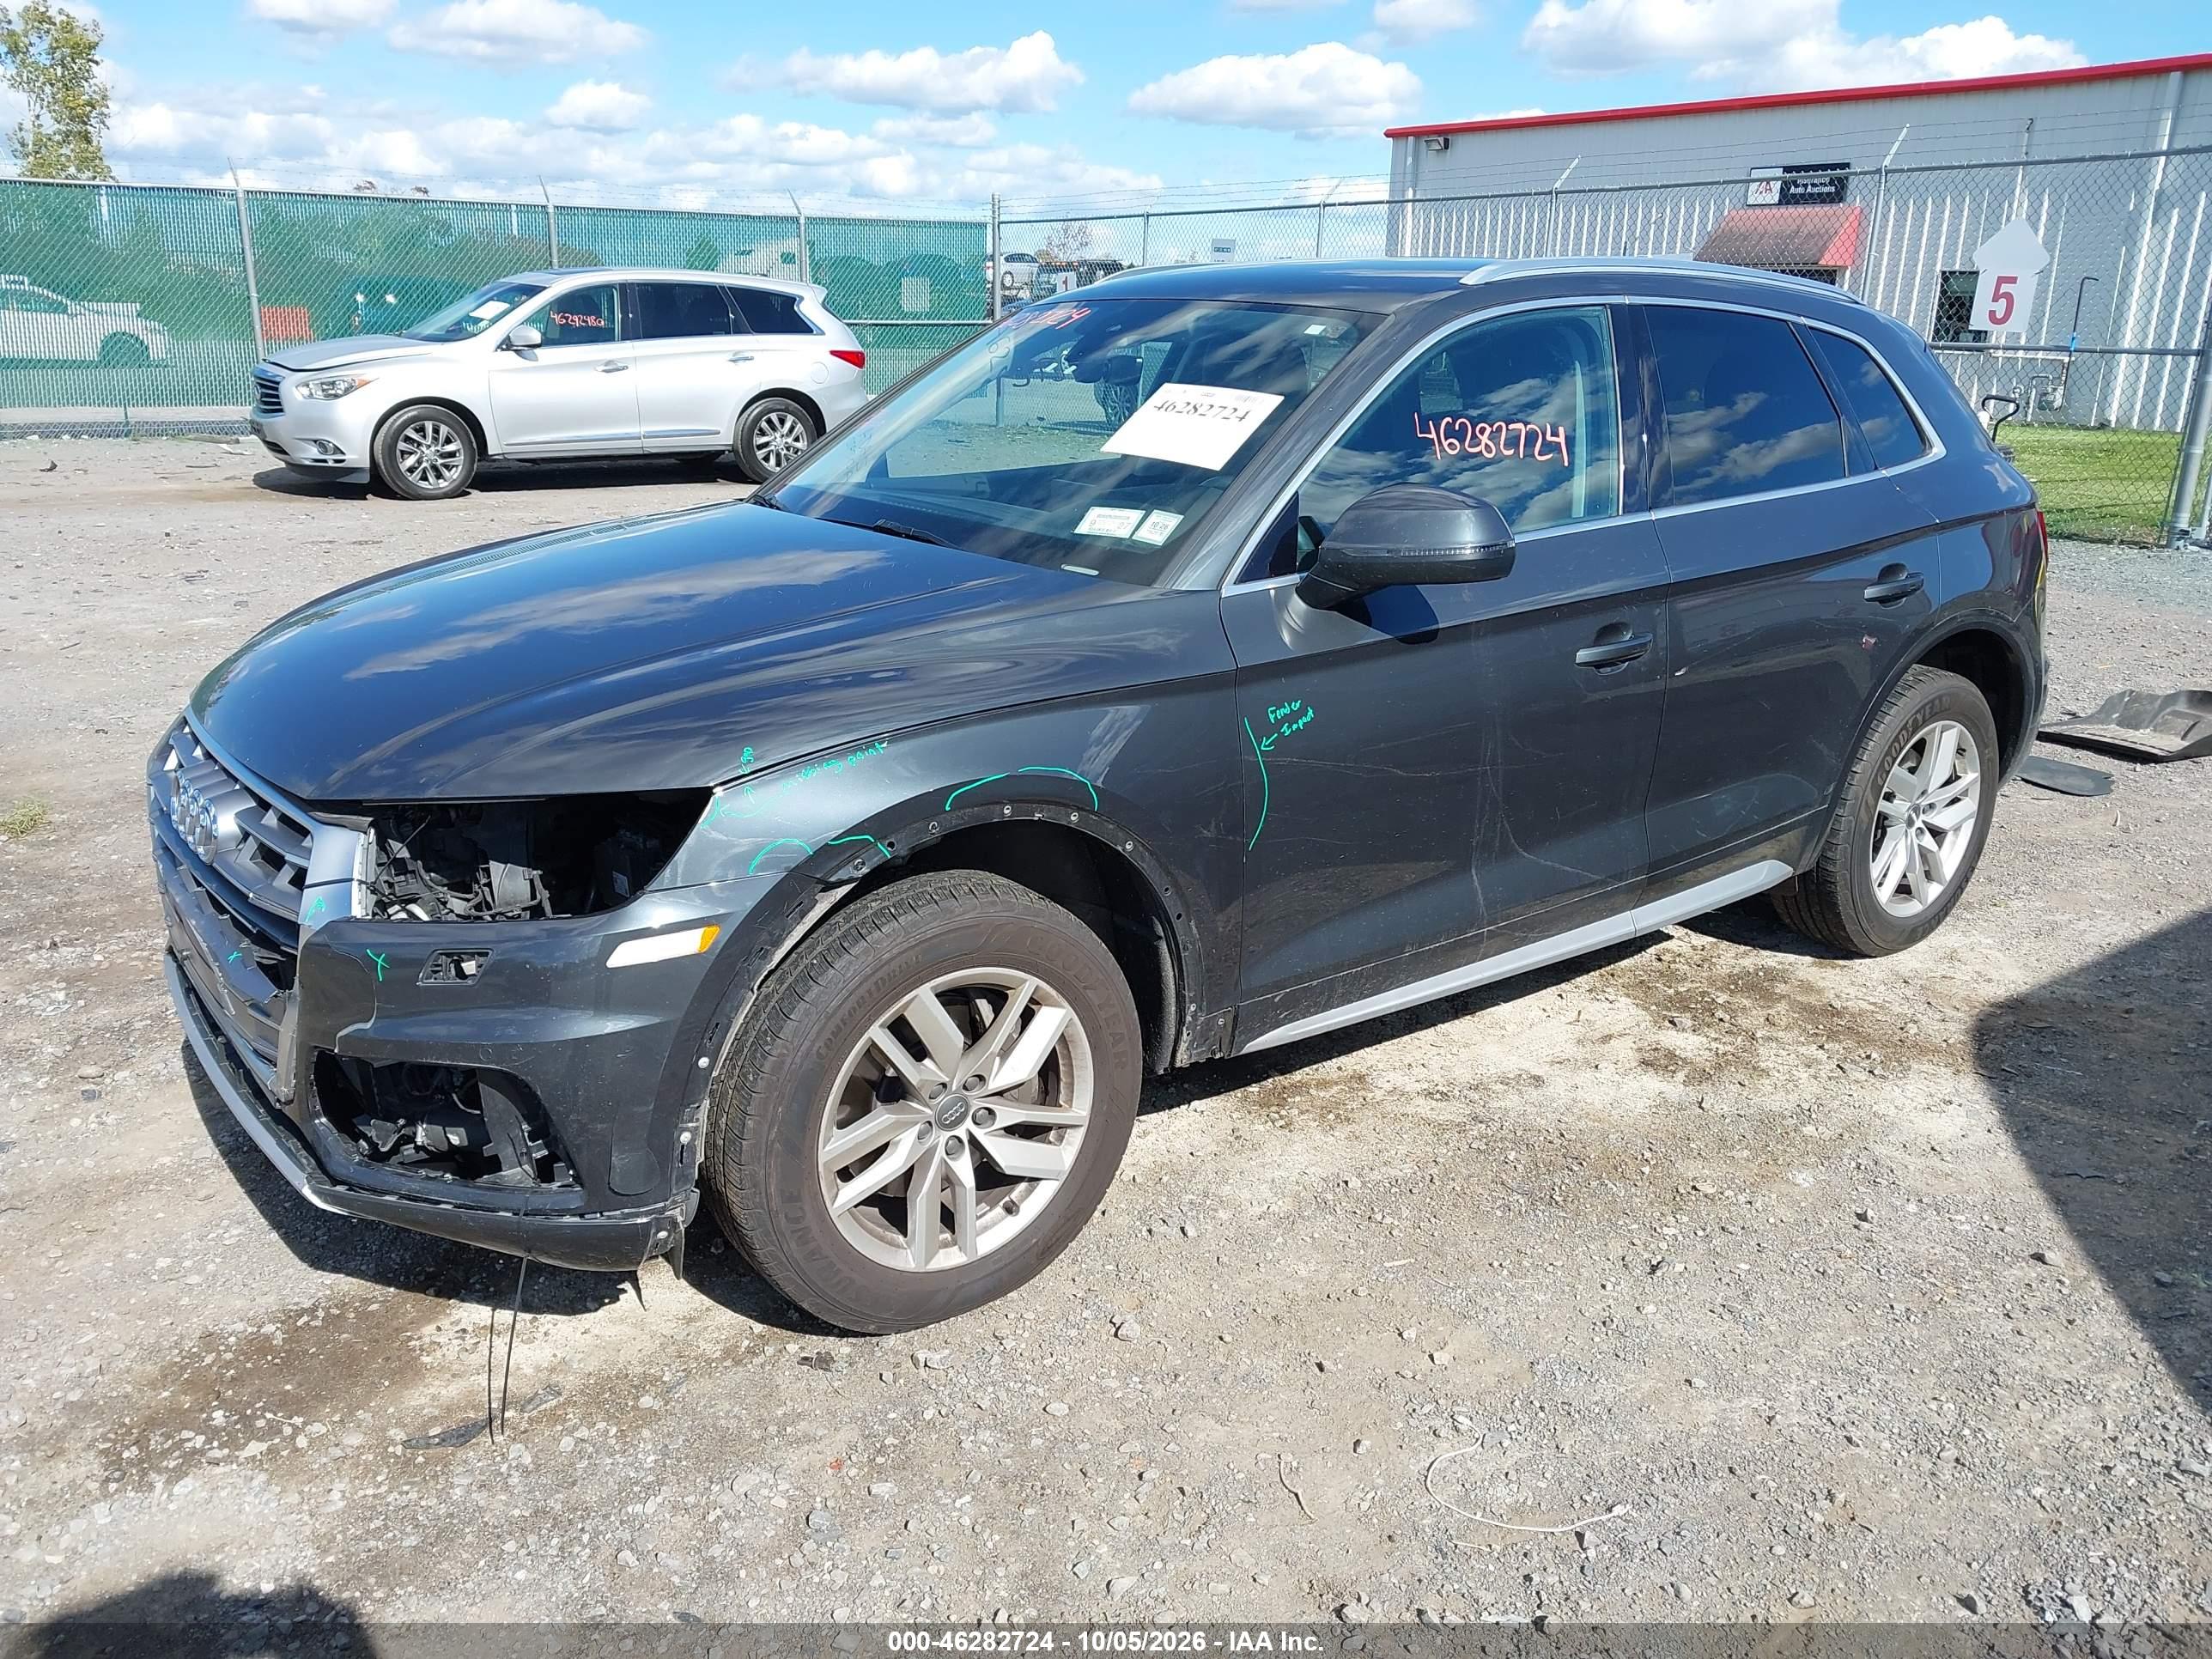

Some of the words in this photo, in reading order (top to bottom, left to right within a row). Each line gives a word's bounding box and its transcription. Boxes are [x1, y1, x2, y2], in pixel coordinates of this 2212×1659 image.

[1062, 276, 1068, 292] 1
[1988, 276, 2019, 325] 5
[1153, 399, 1252, 422] 46282724
[1414, 411, 1570, 467] 46282724
[1267, 700, 1302, 724] Fender
